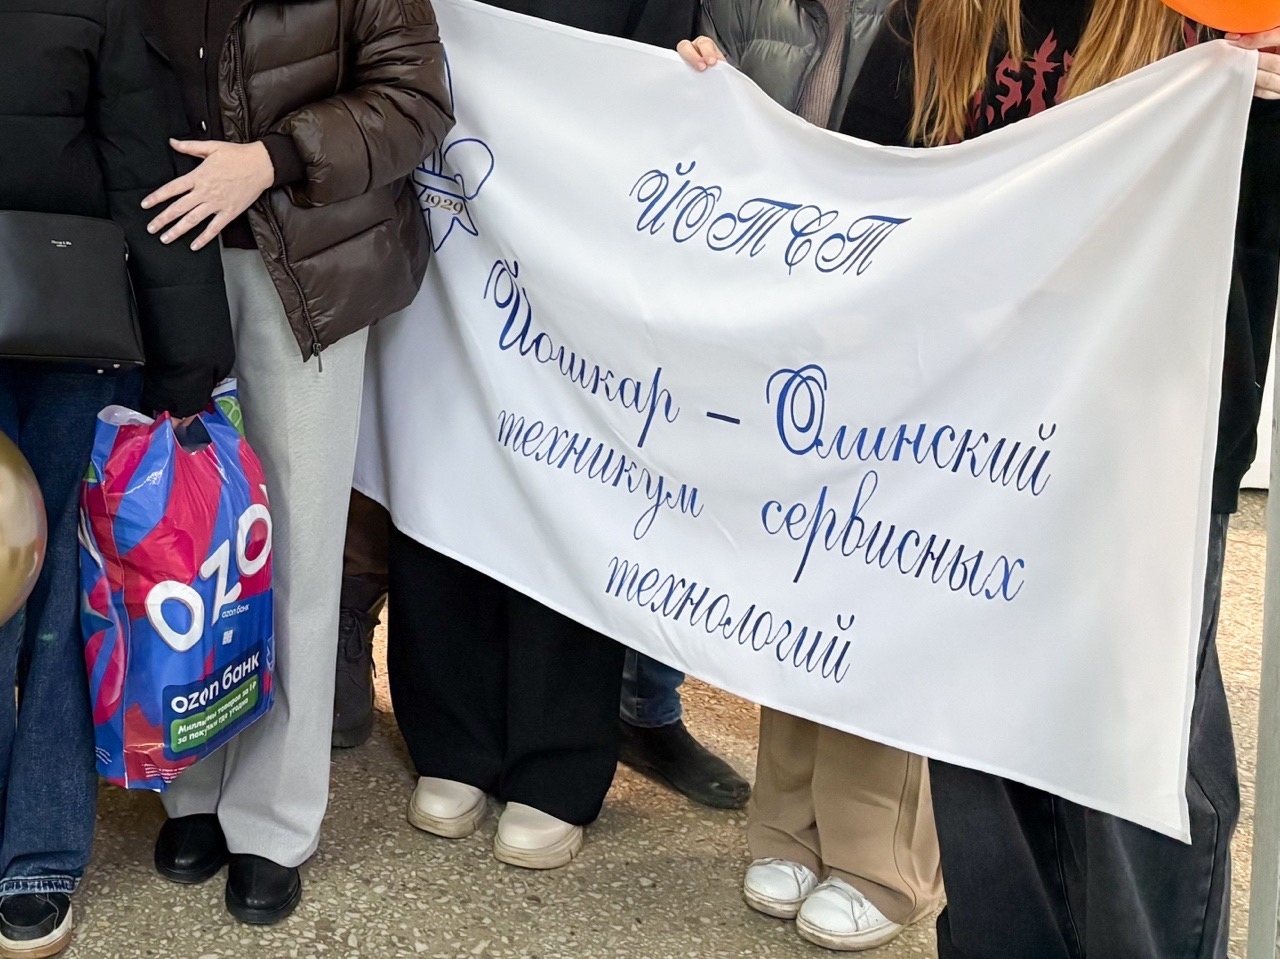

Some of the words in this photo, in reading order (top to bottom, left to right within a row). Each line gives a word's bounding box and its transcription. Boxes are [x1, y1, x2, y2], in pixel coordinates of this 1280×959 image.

[424, 193, 464, 216] 1929
[483, 259, 680, 448] Йошкар
[766, 363, 1056, 496] Олинский
[497, 409, 704, 541] техникум
[761, 470, 1025, 601] сервисных
[605, 556, 855, 684] технологий
[170, 680, 219, 714] ozon
[222, 651, 260, 690] банк
[177, 734, 188, 745] за
